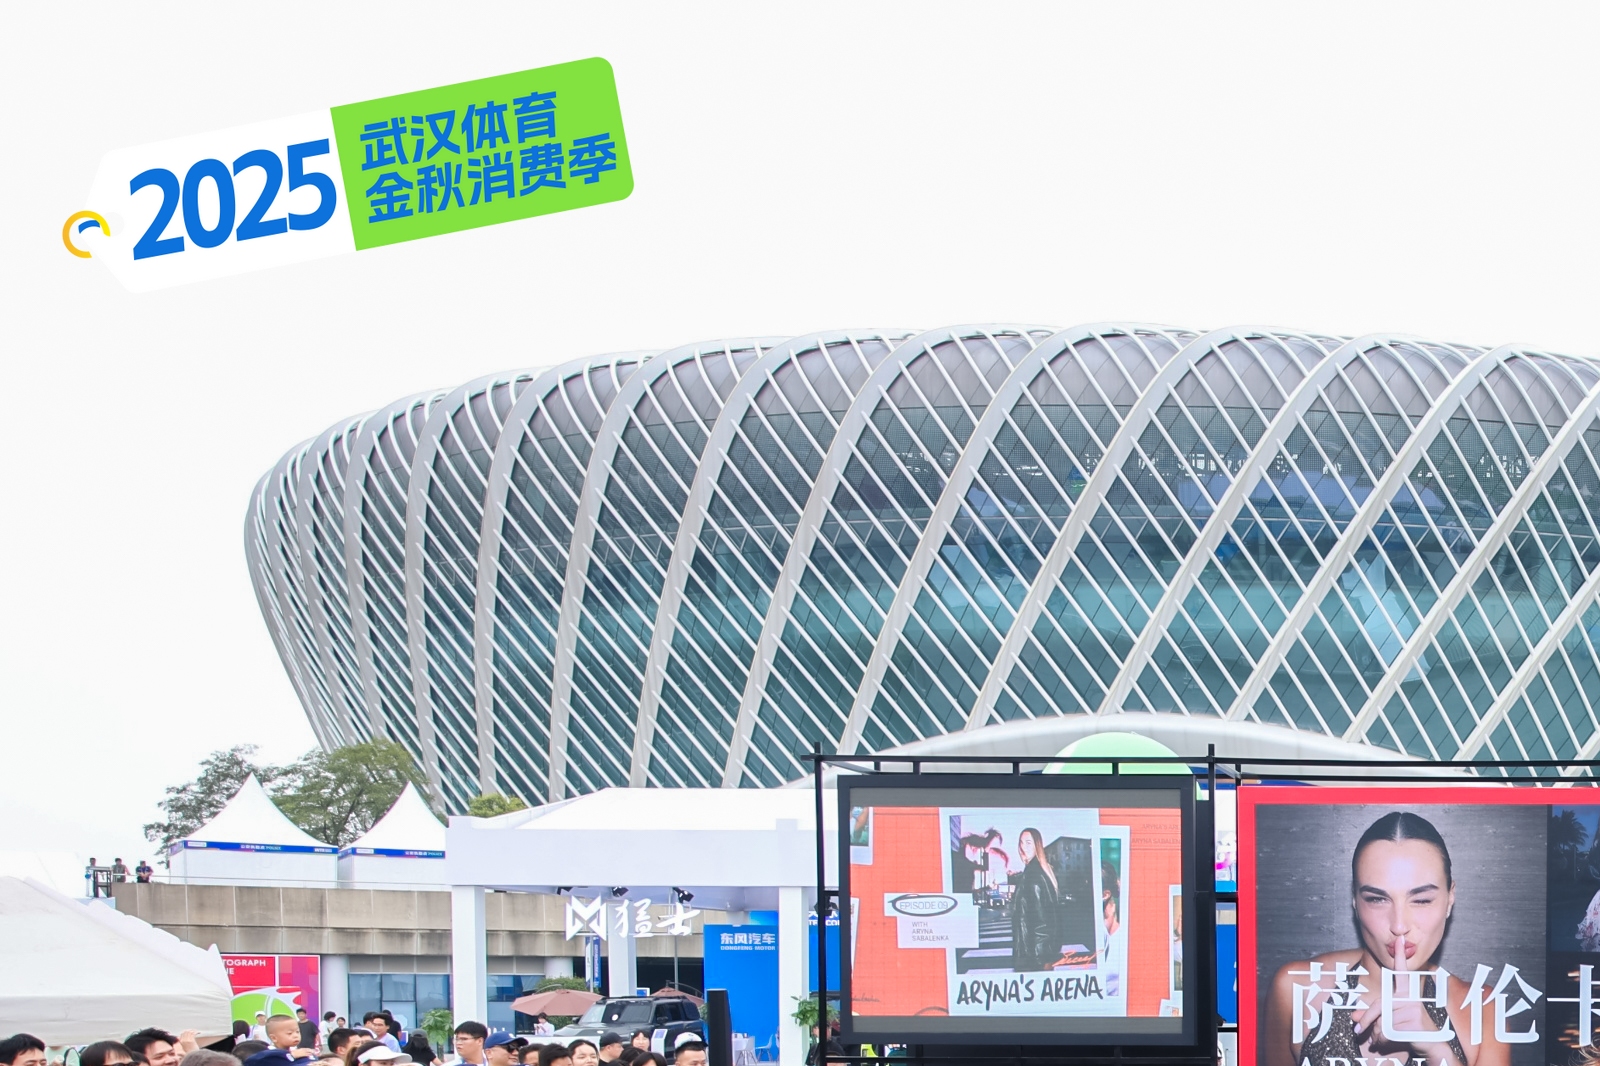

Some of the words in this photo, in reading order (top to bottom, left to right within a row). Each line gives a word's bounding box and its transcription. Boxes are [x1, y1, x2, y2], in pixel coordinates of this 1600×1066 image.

[900, 901, 936, 910] EPISODE
[937, 900, 949, 910] 09
[614, 898, 700, 938] 猛士
[720, 932, 775, 945] 东风汽车
[957, 974, 1035, 1011] ARYNA'S
[1041, 974, 1104, 1002] ARENA
